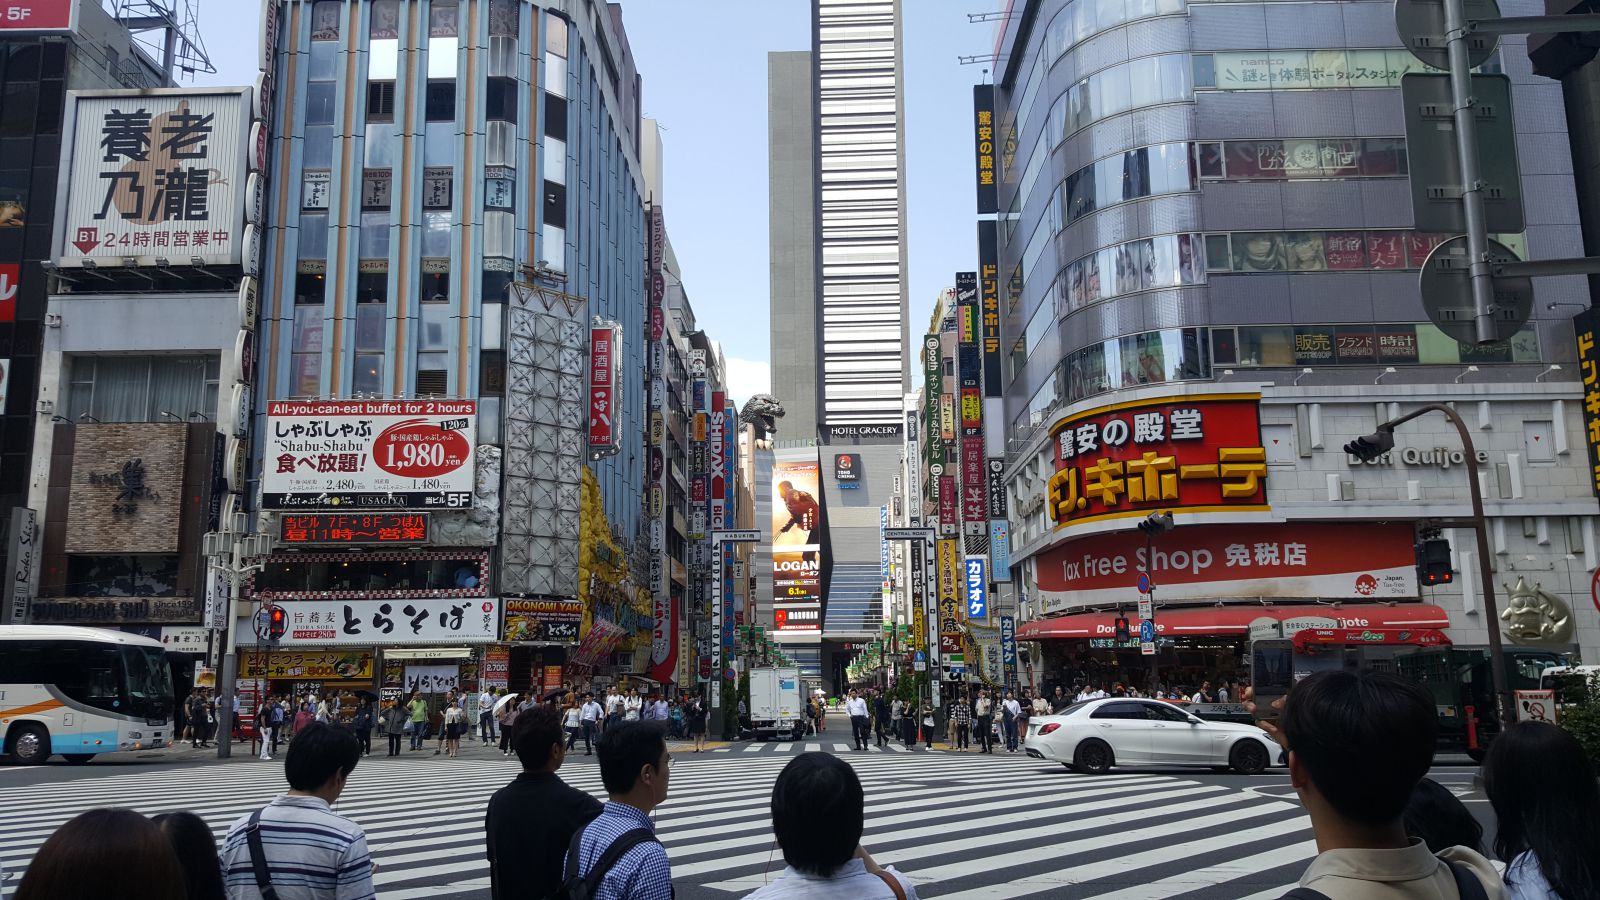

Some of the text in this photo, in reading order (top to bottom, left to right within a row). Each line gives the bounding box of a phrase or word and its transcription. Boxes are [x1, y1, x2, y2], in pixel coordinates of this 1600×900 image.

[7, 8, 31, 20] 5F
[102, 108, 214, 162] 養老
[978, 110, 994, 184] 驚安の殿堂
[94, 167, 209, 221] 乃瀧
[80, 230, 97, 242] B1
[104, 229, 229, 248] 24時間営業中
[1328, 236, 1361, 252] 新宿
[1296, 334, 1330, 351] 販売
[1337, 336, 1373, 346] ブランド
[1380, 336, 1414, 347] 時計
[594, 340, 608, 382] 居酒屋
[926, 338, 939, 370] Booth
[273, 402, 472, 414] All-you-can-eat buffet for 2 hours
[590, 392, 610, 426] つぼ八
[275, 420, 372, 438] しゃぶしゃぶ
[442, 420, 466, 430] 120分
[831, 426, 898, 435] HOTEL GRACERY
[1060, 408, 1203, 460] 驚安の殿堂
[712, 411, 724, 478] SHIDAX
[276, 454, 367, 473] 食べ放題!
[385, 443, 444, 470] 1,980
[1402, 448, 1489, 468] Quijoe
[326, 479, 354, 490] 2,480
[412, 478, 440, 490] 1,480
[426, 494, 469, 506] 当ビル 5F
[286, 517, 320, 528] 当ビル
[713, 505, 722, 524] BIC
[774, 561, 818, 571] LOGAN
[1062, 542, 1307, 582] Tax Free Shop 免税店
[969, 561, 983, 615] カラオケ
[928, 558, 937, 647] ゴジラロード
[343, 603, 472, 634] とらそば
[1002, 619, 1014, 662] カラオケ
[408, 675, 458, 688] とらそば
